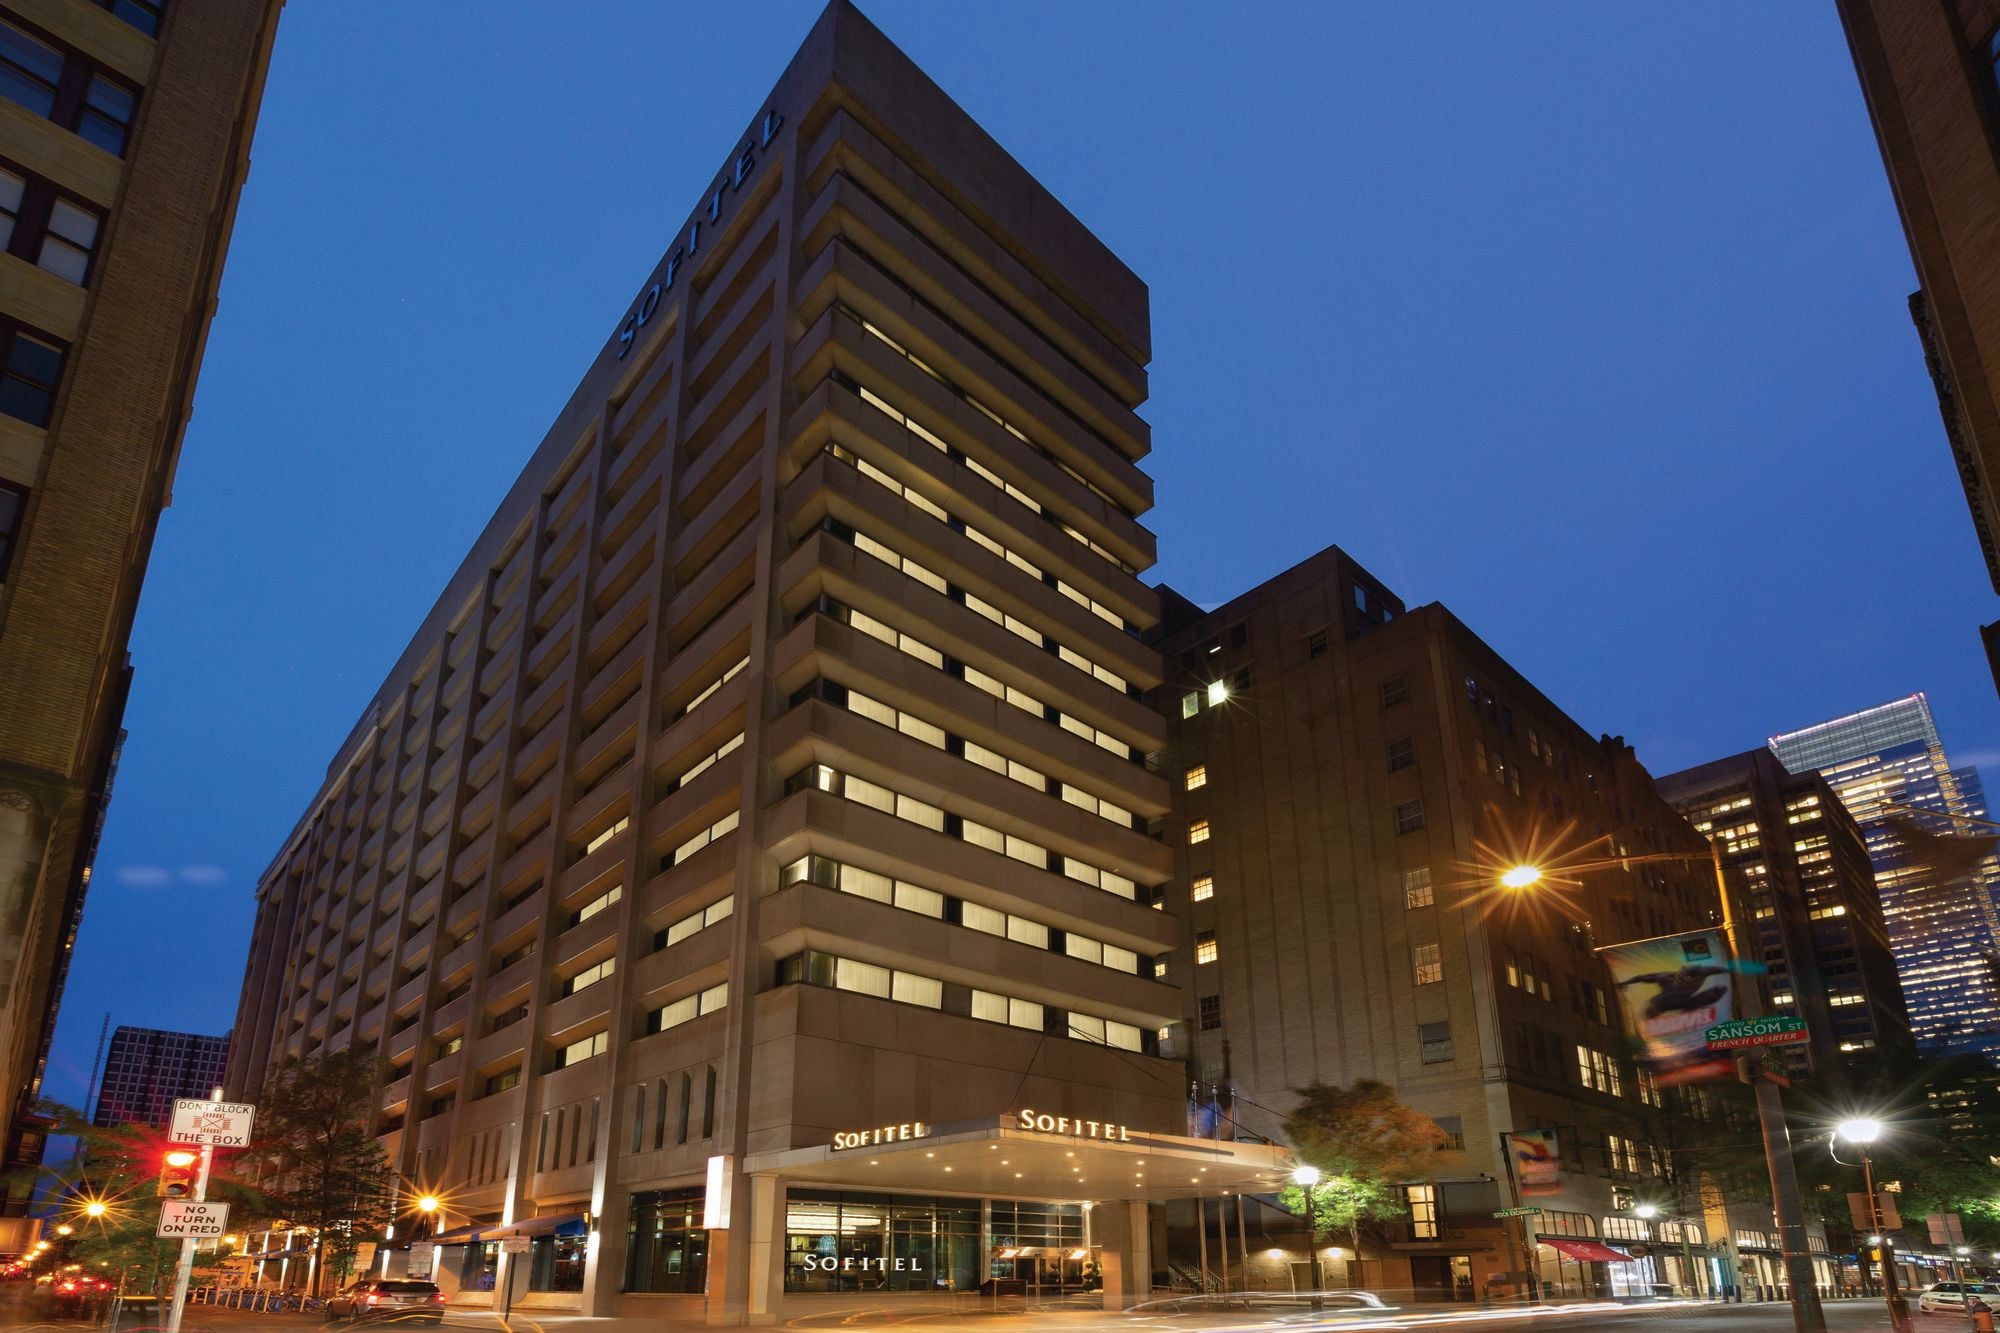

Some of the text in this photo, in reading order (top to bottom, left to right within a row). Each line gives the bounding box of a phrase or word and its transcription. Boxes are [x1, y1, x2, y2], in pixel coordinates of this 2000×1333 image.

[618, 110, 785, 360] SOFITEL
[1708, 1022, 1802, 1041] SANSOM ST
[1711, 1033, 1797, 1049] FRENCH QUARTER
[179, 1101, 249, 1114] DONT BLOCK
[1020, 1109, 1131, 1141] SOFITEL
[175, 1132, 243, 1145] THE BOX
[834, 1122, 925, 1149] SOFITEL
[185, 1206, 207, 1214] NO
[173, 1215, 216, 1224] TURN
[163, 1224, 220, 1234] ON RED
[803, 1254, 922, 1271] SOFITEL
